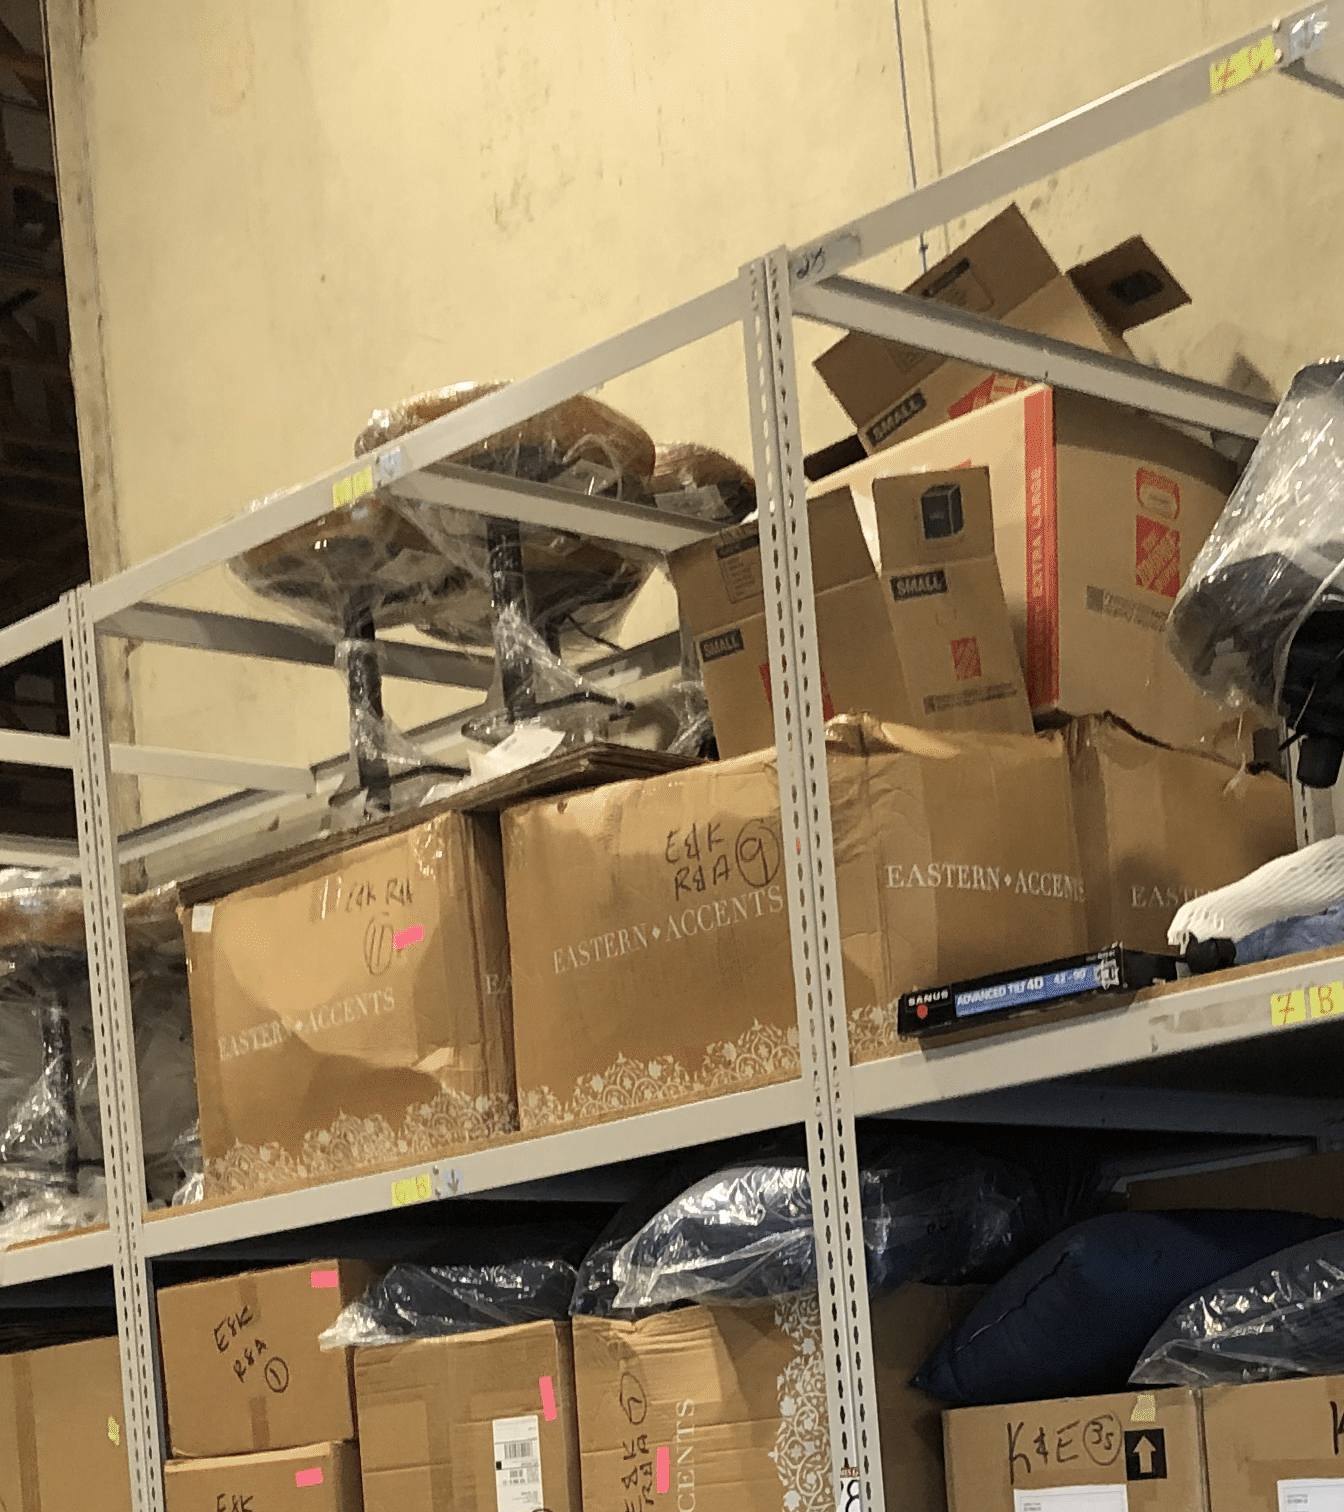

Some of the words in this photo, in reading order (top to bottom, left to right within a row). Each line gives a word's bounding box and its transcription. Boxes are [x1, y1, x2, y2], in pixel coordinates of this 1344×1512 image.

[895, 573, 944, 598] SMALL
[703, 633, 740, 658] SMALL
[885, 864, 1001, 891] EASTERN
[552, 923, 648, 975] EASTERN
[665, 885, 785, 942] ACCENTS
[908, 989, 949, 1006] SANUS
[956, 986, 1006, 1007] ADVANCED
[217, 1015, 293, 1062] EASTERN
[300, 986, 396, 1034] ACCENTS
